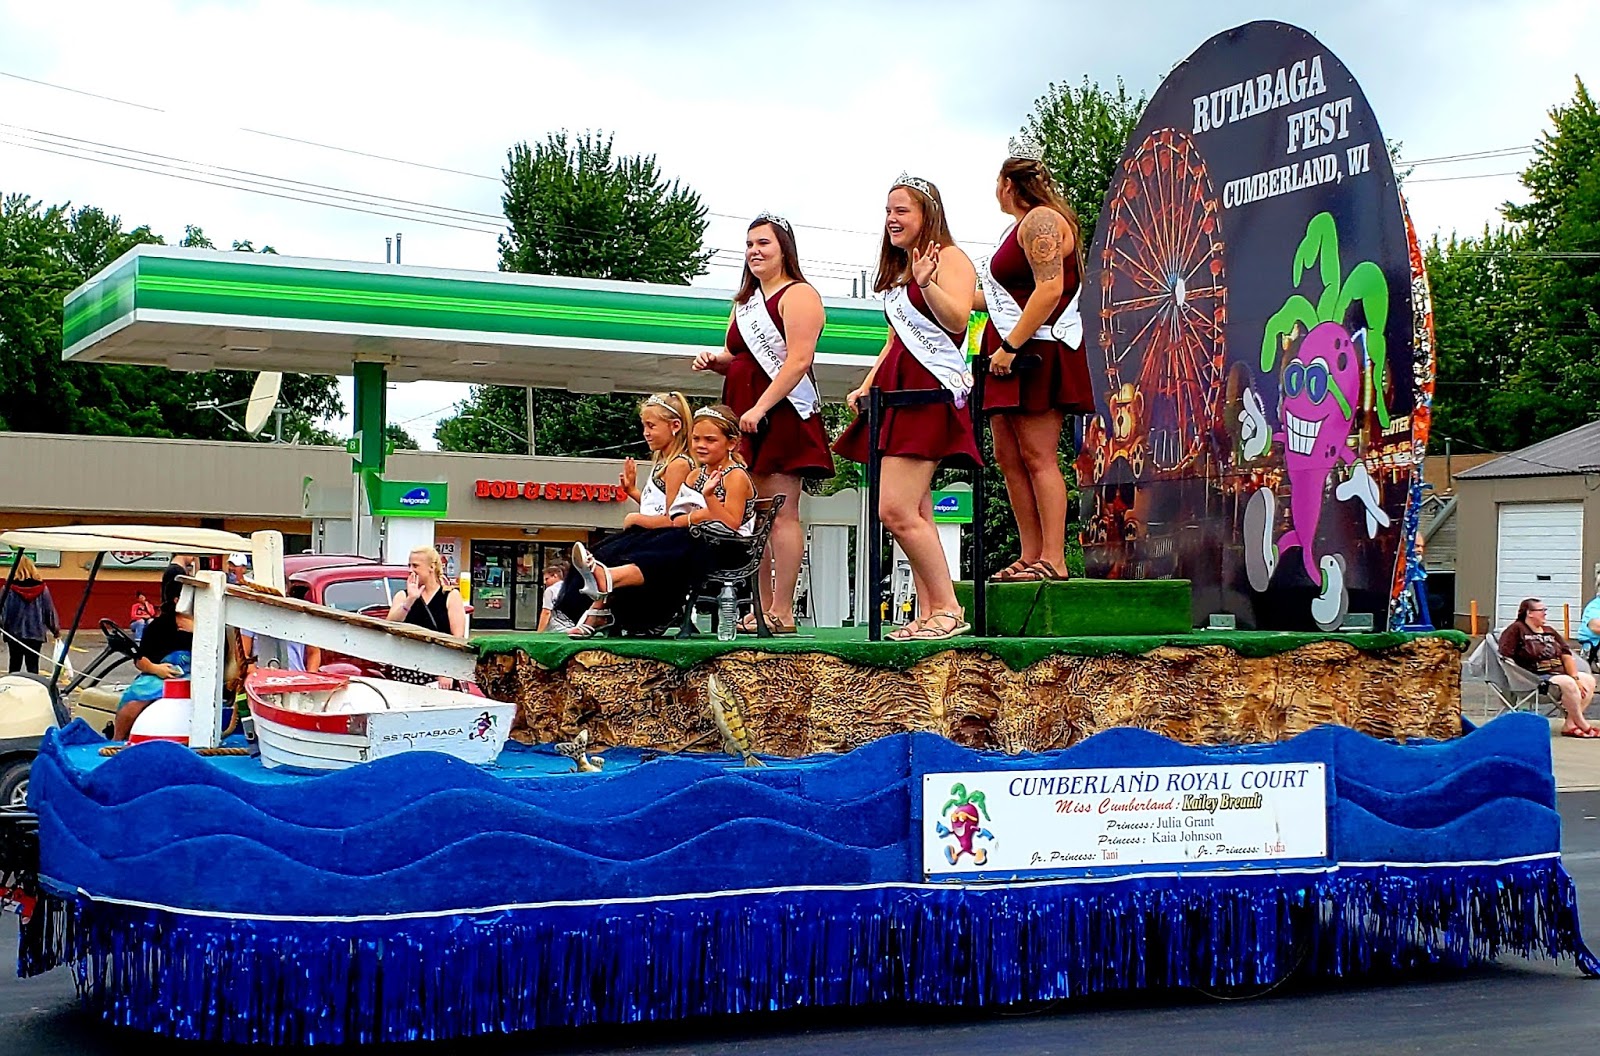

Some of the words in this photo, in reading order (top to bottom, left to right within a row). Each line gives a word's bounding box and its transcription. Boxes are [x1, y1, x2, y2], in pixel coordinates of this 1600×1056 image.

[1192, 55, 1327, 135] RUTABAGA
[1287, 97, 1352, 154] FEST
[1223, 153, 1342, 210] CUMBERLAND,
[1347, 143, 1370, 176] WI
[750, 320, 761, 334] 1st
[906, 320, 938, 355] Princess
[349, 440, 356, 450] 8
[475, 480, 519, 500] BOB
[523, 481, 541, 500] &
[544, 482, 628, 503] STEVE'S
[383, 734, 398, 742] SS
[403, 727, 464, 740] RUTABAGA
[1008, 773, 1160, 797] CUMBERLAND
[1166, 771, 1232, 791] ROYAL
[1241, 769, 1309, 789] COURT
[1055, 799, 1092, 813] Miss
[1182, 793, 1218, 814] Kailey
[1219, 791, 1263, 810] Breault
[1106, 819, 1154, 830] Princess:
[1156, 817, 1181, 829] Julia
[1185, 815, 1215, 828] Grant
[1152, 832, 1177, 843] Kaia
[1180, 831, 1222, 842] Johnson
[1030, 851, 1046, 865] Jr.
[1050, 850, 1097, 862] Princess:
[1101, 848, 1119, 860] Tani
[1197, 844, 1213, 858] Jr.
[1215, 844, 1260, 855] Princess:
[1264, 842, 1286, 855] Lydia
